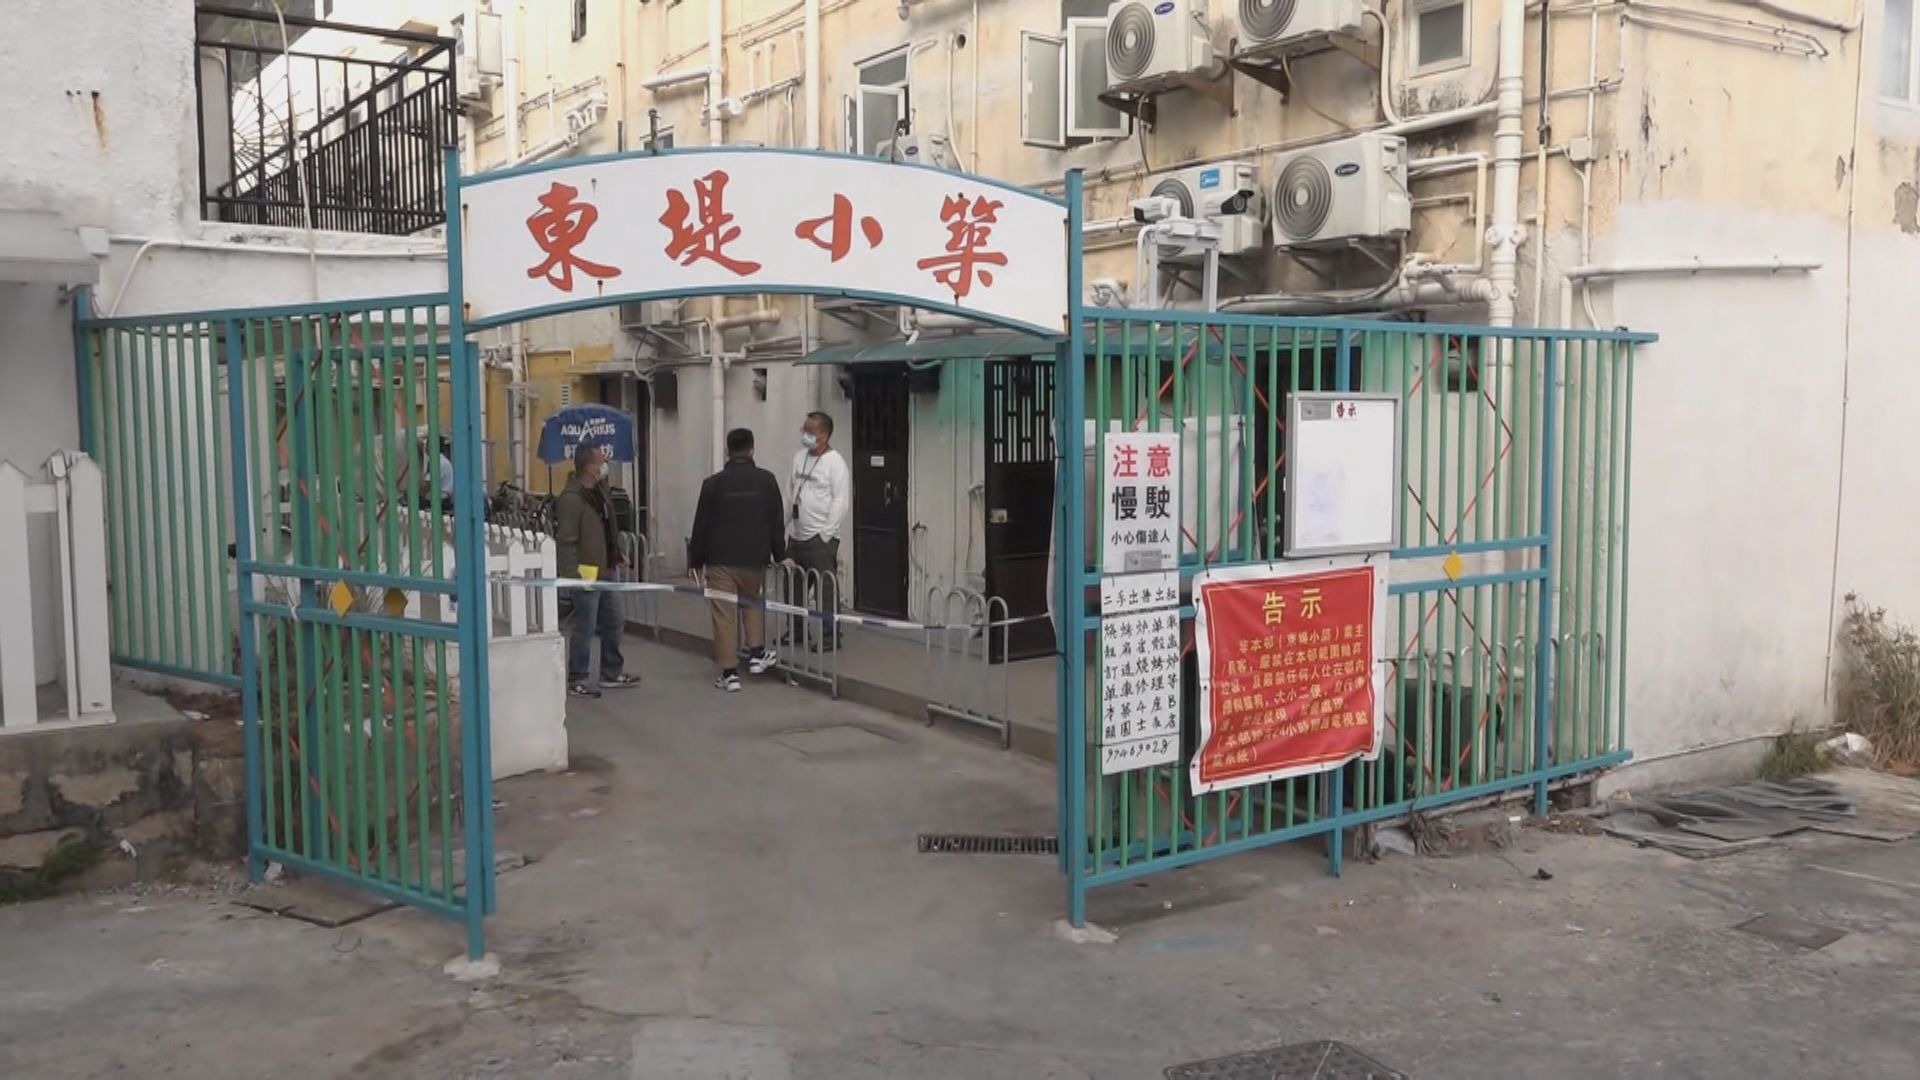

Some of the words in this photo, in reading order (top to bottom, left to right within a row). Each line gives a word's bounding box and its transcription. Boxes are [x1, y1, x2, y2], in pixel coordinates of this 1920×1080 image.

[526, 169, 1009, 297] 東堤小築
[560, 419, 615, 441] AQUARIUS
[1112, 444, 1171, 478] 注意
[1112, 486, 1170, 520] 慢駛
[1262, 588, 1322, 625] 告示
